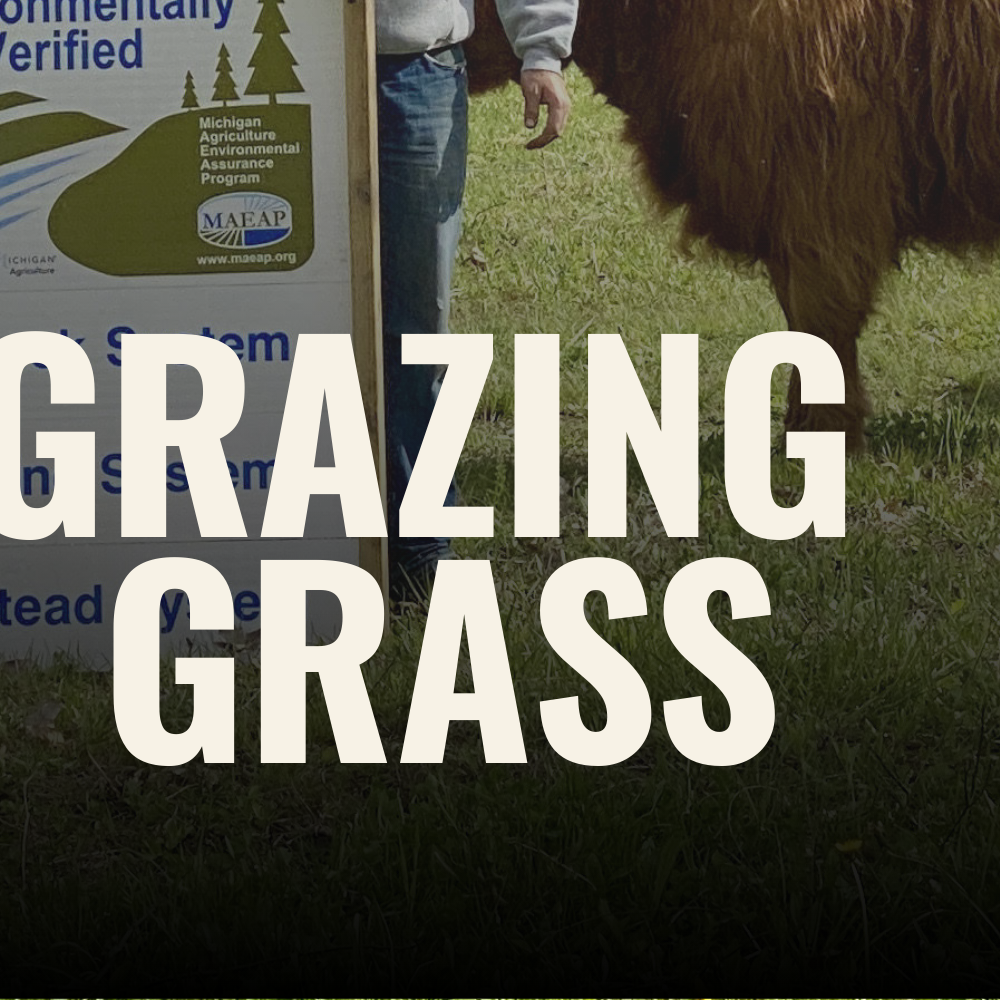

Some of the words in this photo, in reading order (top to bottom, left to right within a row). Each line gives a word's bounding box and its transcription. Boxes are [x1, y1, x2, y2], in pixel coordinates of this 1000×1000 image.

[199, 117, 262, 131] Michigan
[199, 130, 277, 144] Agriculture
[200, 142, 301, 157] Environmental
[200, 158, 274, 171] Assurance
[201, 172, 260, 186] Program
[203, 210, 287, 229] MAEAP
[197, 251, 297, 266] www.maeap.org
